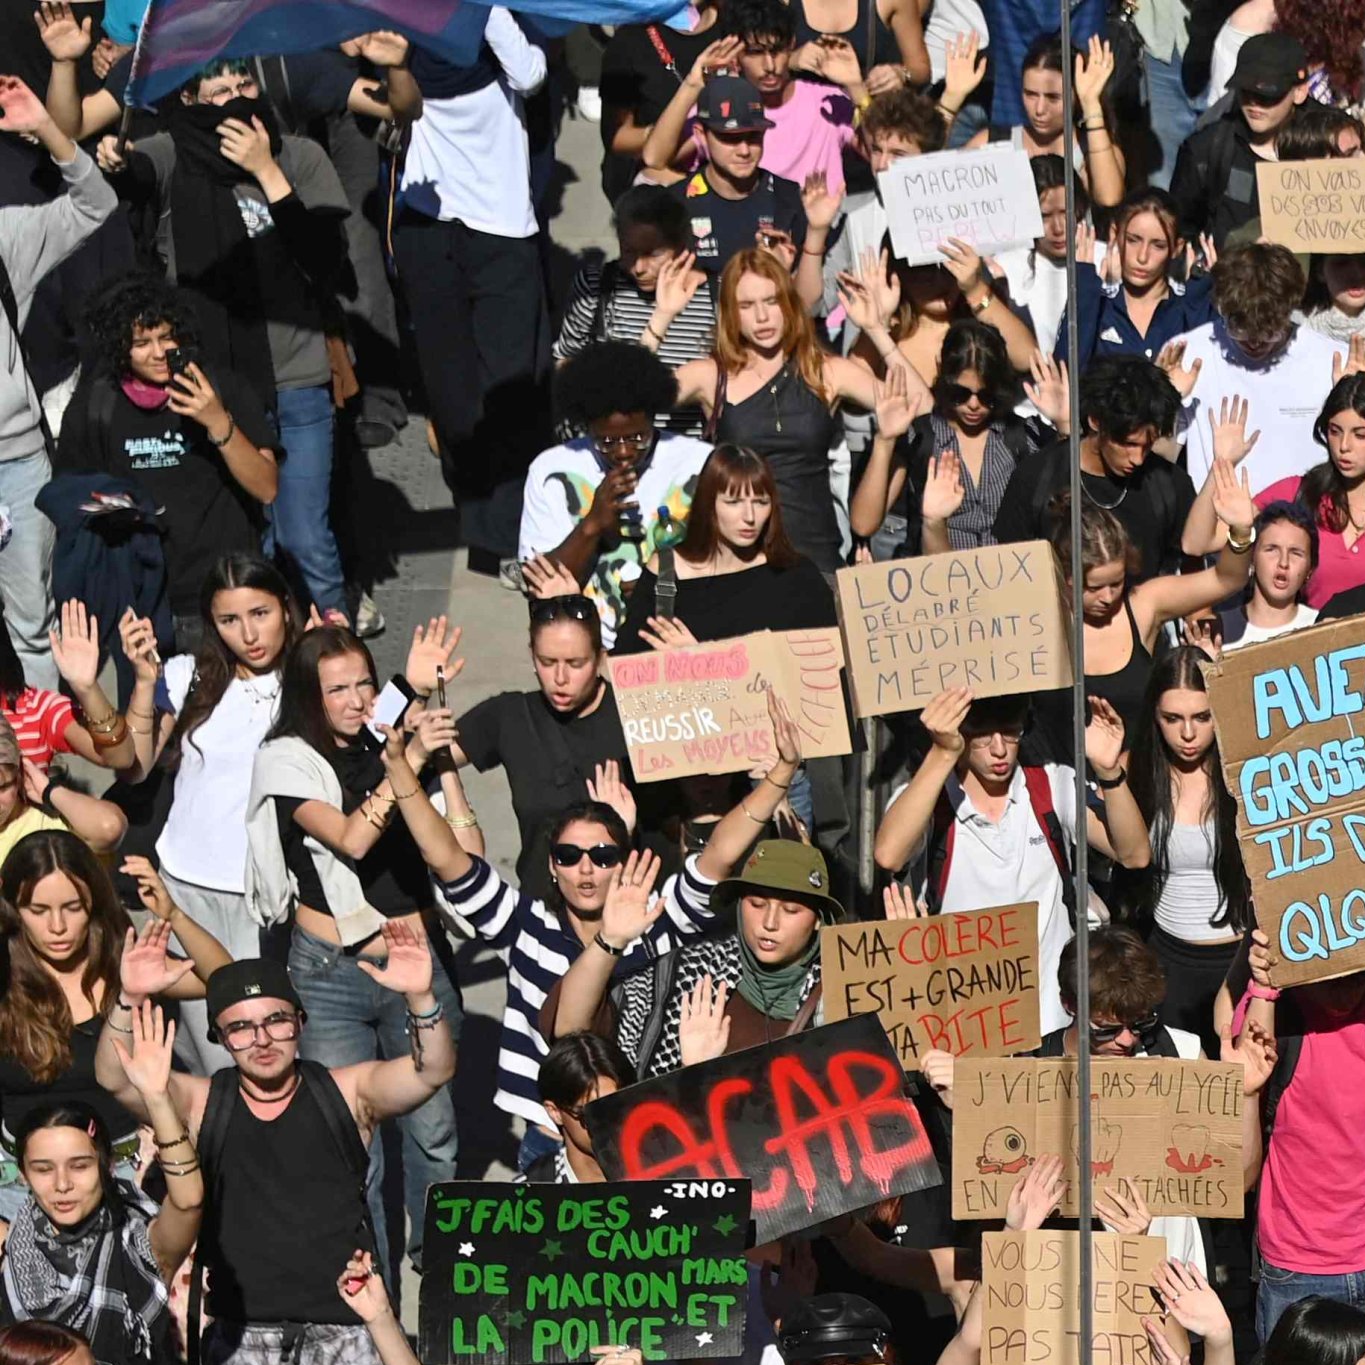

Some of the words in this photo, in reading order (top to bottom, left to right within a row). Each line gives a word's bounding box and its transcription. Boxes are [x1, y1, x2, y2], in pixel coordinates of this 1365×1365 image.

[904, 163, 999, 199] MACRON
[1281, 168, 1311, 192] ON
[1317, 169, 1362, 190] VOUS
[913, 207, 944, 225] PAS
[948, 203, 969, 221] DU
[971, 198, 1006, 217] TOUT
[854, 551, 1033, 610] LOCAUX
[863, 588, 980, 633] DÉLABRÉ
[614, 658, 659, 689] ON
[665, 644, 750, 682] NOUS
[878, 644, 1049, 705] MÉPRISÉ
[624, 707, 722, 747] REUSSIR
[683, 728, 771, 764] MOYENS
[1253, 817, 1335, 880] ILS
[837, 927, 895, 972] MA
[898, 910, 1020, 965] COLÈRE
[845, 974, 897, 1016] EST
[901, 986, 924, 1011] +
[926, 955, 1036, 1007] GRANDE
[916, 999, 1025, 1058] BITE
[1101, 1070, 1137, 1099] PAS
[1147, 1070, 1174, 1098] AU
[1175, 1066, 1243, 1118] LYCÉE
[618, 1050, 934, 1210] ACAB
[557, 1195, 630, 1232] DES
[962, 1178, 999, 1213] EN
[681, 1257, 749, 1287] MARS
[985, 1239, 1064, 1272] VOUS
[1094, 1240, 1140, 1273] NE
[453, 1262, 509, 1298] DE
[525, 1269, 678, 1312] MACRON
[988, 1280, 1065, 1311] NOUS
[686, 1292, 737, 1329] ET
[452, 1314, 506, 1357] LA
[988, 1325, 1052, 1364] PAS
